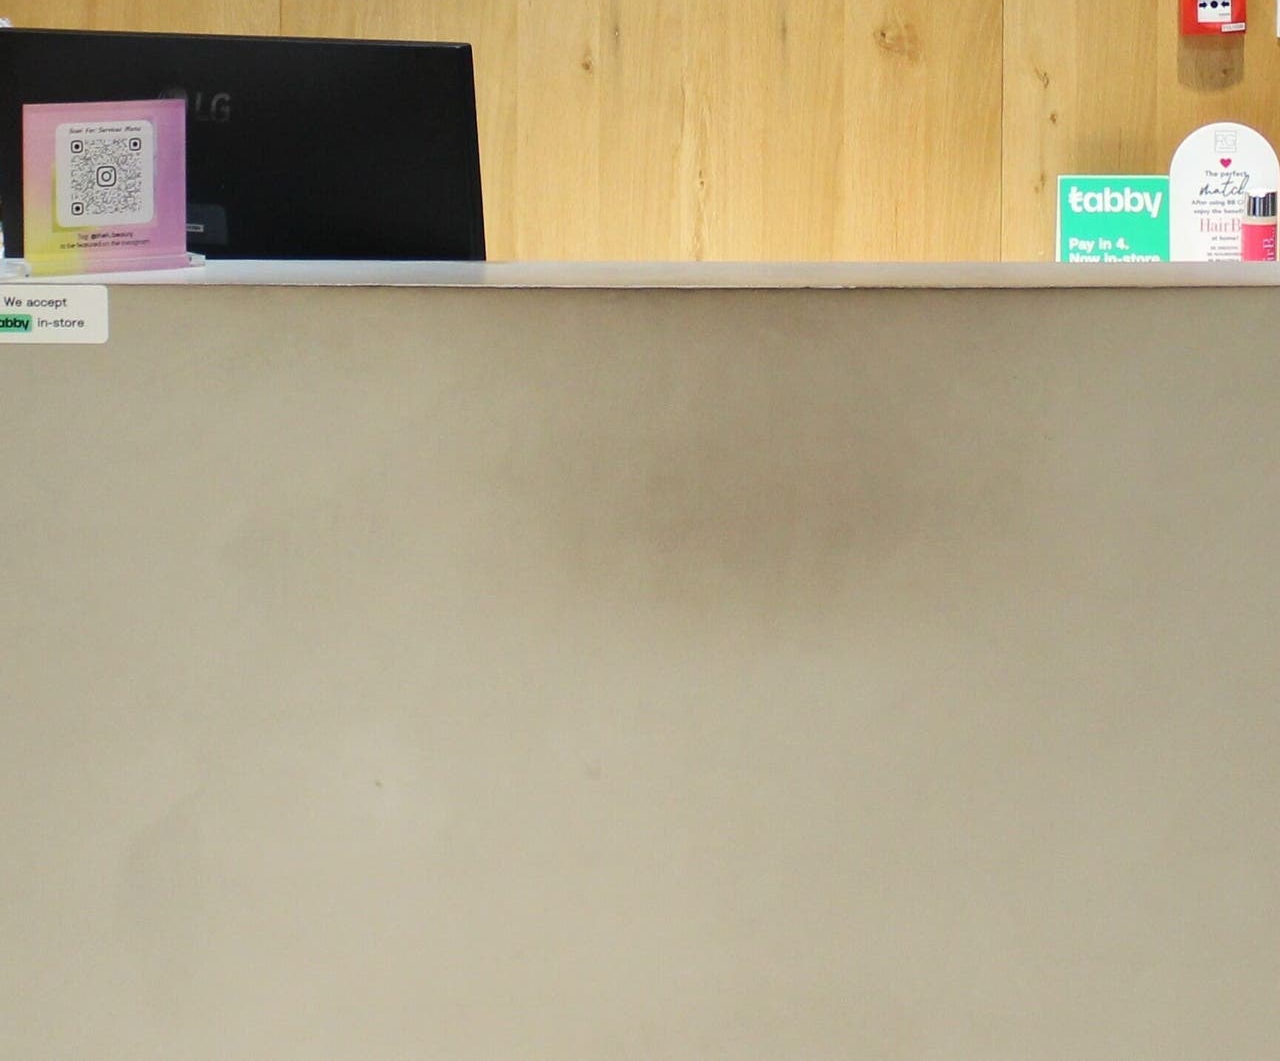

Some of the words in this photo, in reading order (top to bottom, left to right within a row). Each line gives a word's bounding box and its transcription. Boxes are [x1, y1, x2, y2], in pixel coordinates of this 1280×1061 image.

[195, 91, 231, 122] LG
[1068, 185, 1163, 219] tabby
[1200, 217, 1241, 233] HairB
[1068, 237, 1096, 253] Pay
[1098, 237, 1112, 250] in
[1115, 237, 1129, 250] 4.
[3, 297, 23, 307] We
[26, 298, 68, 310] accept
[37, 318, 85, 328] in-store
